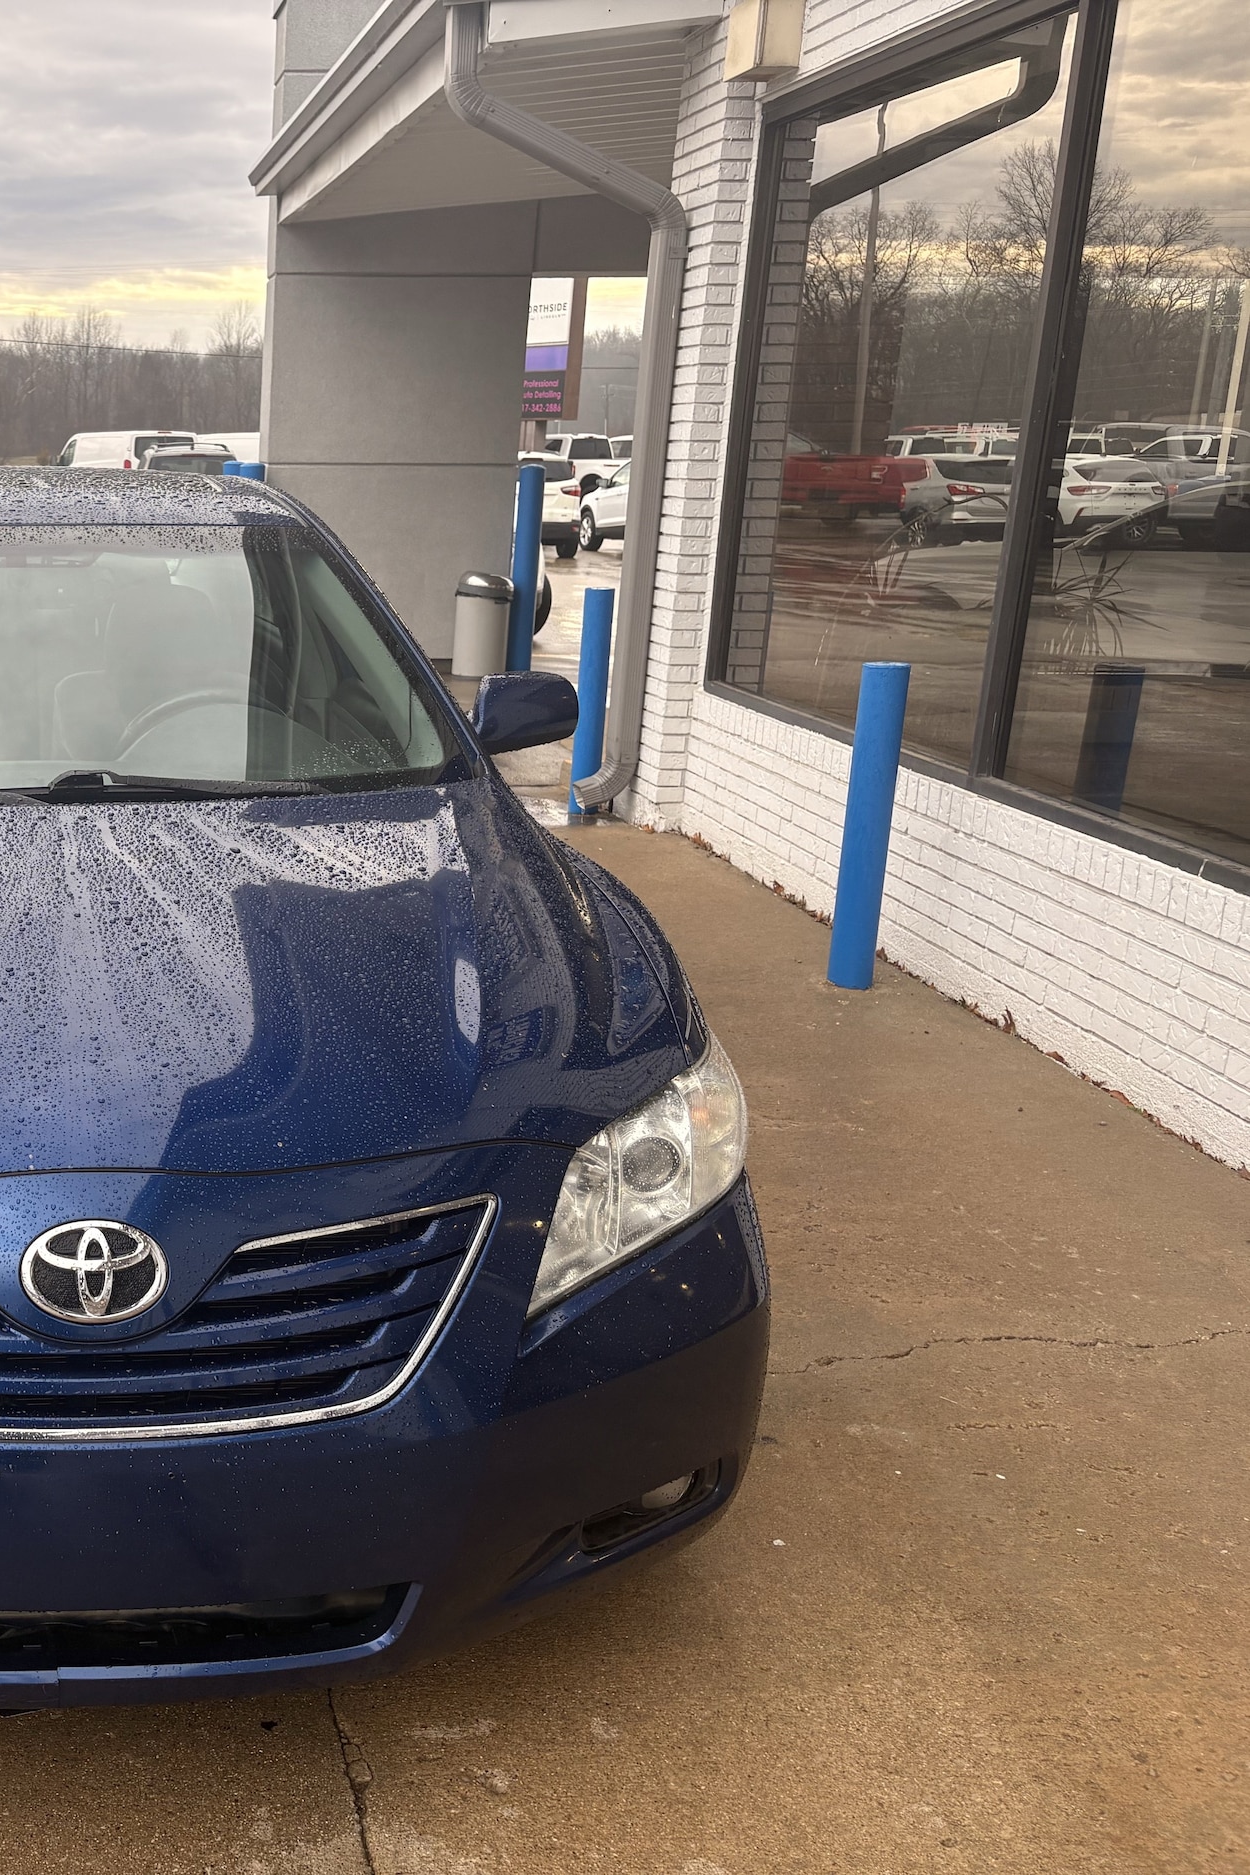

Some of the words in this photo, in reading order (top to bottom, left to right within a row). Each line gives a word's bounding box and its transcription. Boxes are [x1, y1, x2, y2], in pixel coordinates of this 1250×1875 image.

[528, 302, 568, 313] ORTHSIDE
[523, 379, 559, 388] Professional
[523, 391, 533, 399] uto
[534, 390, 562, 400] Detailing
[521, 402, 561, 412] 17-342-2886
